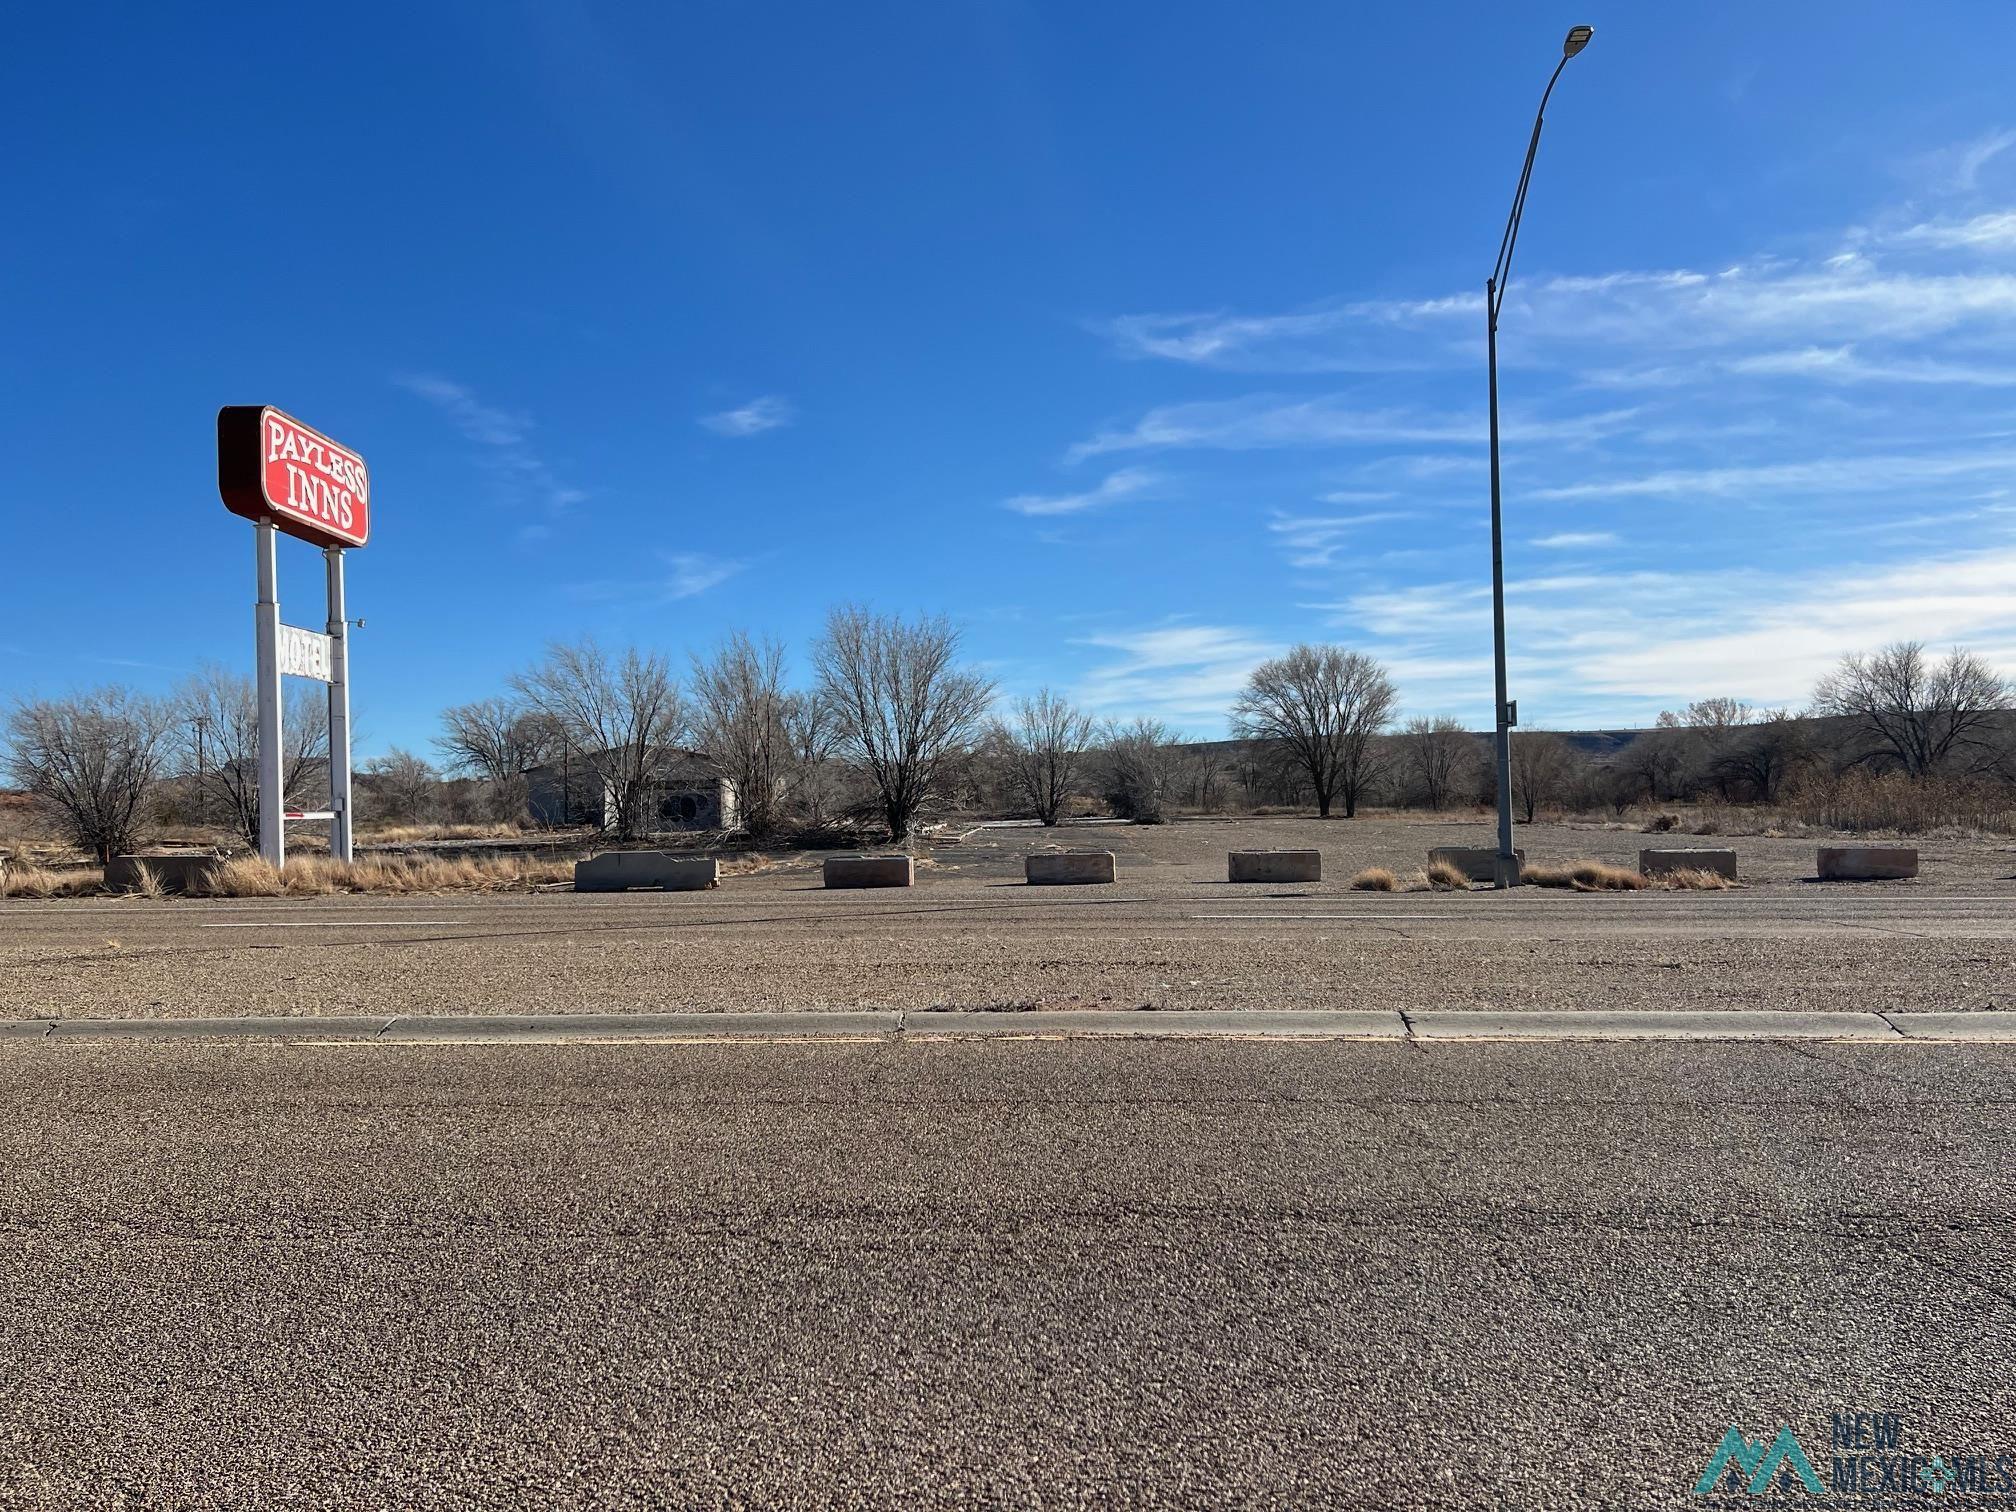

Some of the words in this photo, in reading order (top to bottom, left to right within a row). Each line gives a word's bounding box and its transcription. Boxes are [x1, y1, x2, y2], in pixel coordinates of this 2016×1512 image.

[268, 420, 366, 505] PAYLESS
[286, 463, 353, 530] INNS
[277, 625, 330, 677] MOTEL
